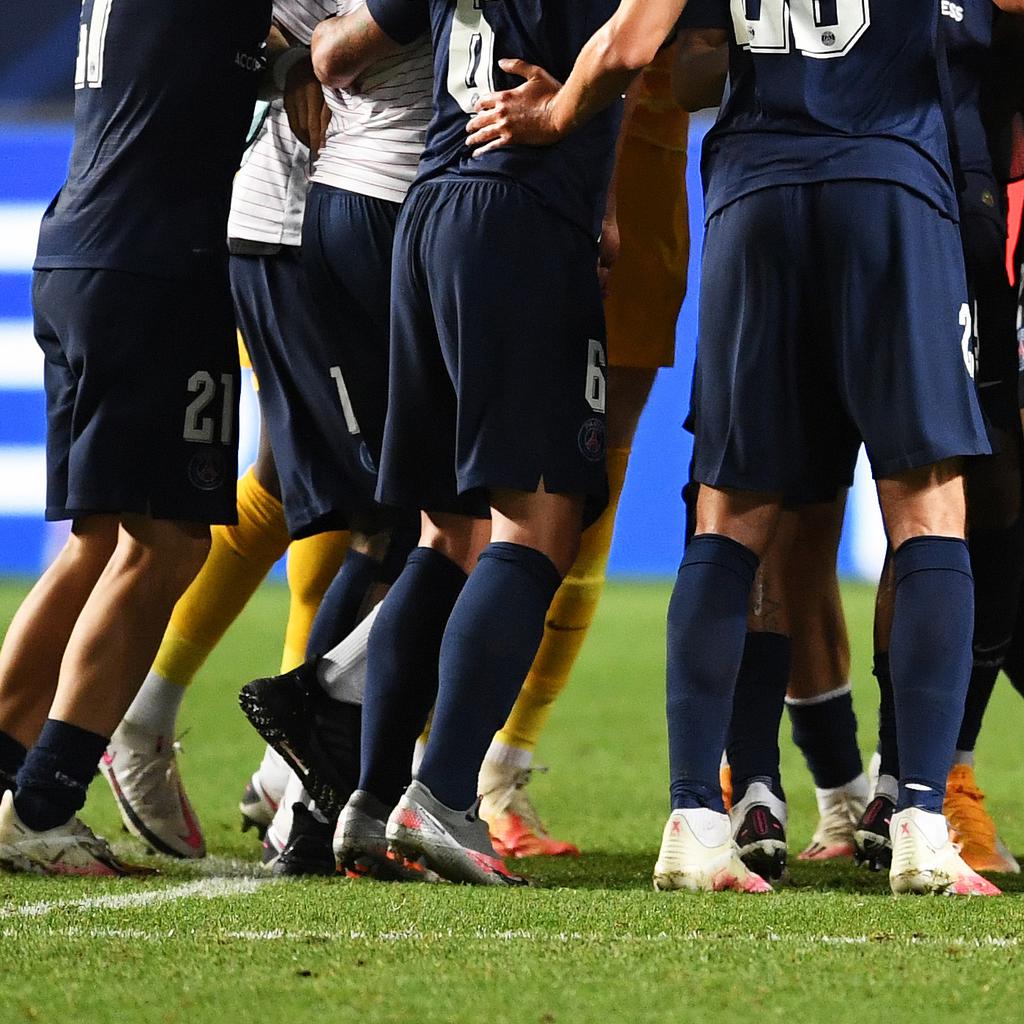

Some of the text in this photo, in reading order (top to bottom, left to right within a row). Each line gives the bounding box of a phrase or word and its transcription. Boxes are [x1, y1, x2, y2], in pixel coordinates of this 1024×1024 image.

[941, 0, 964, 22] ESS
[585, 338, 606, 414] 6
[959, 299, 979, 381] 2
[183, 370, 233, 445] 21
[331, 366, 360, 435] 1
